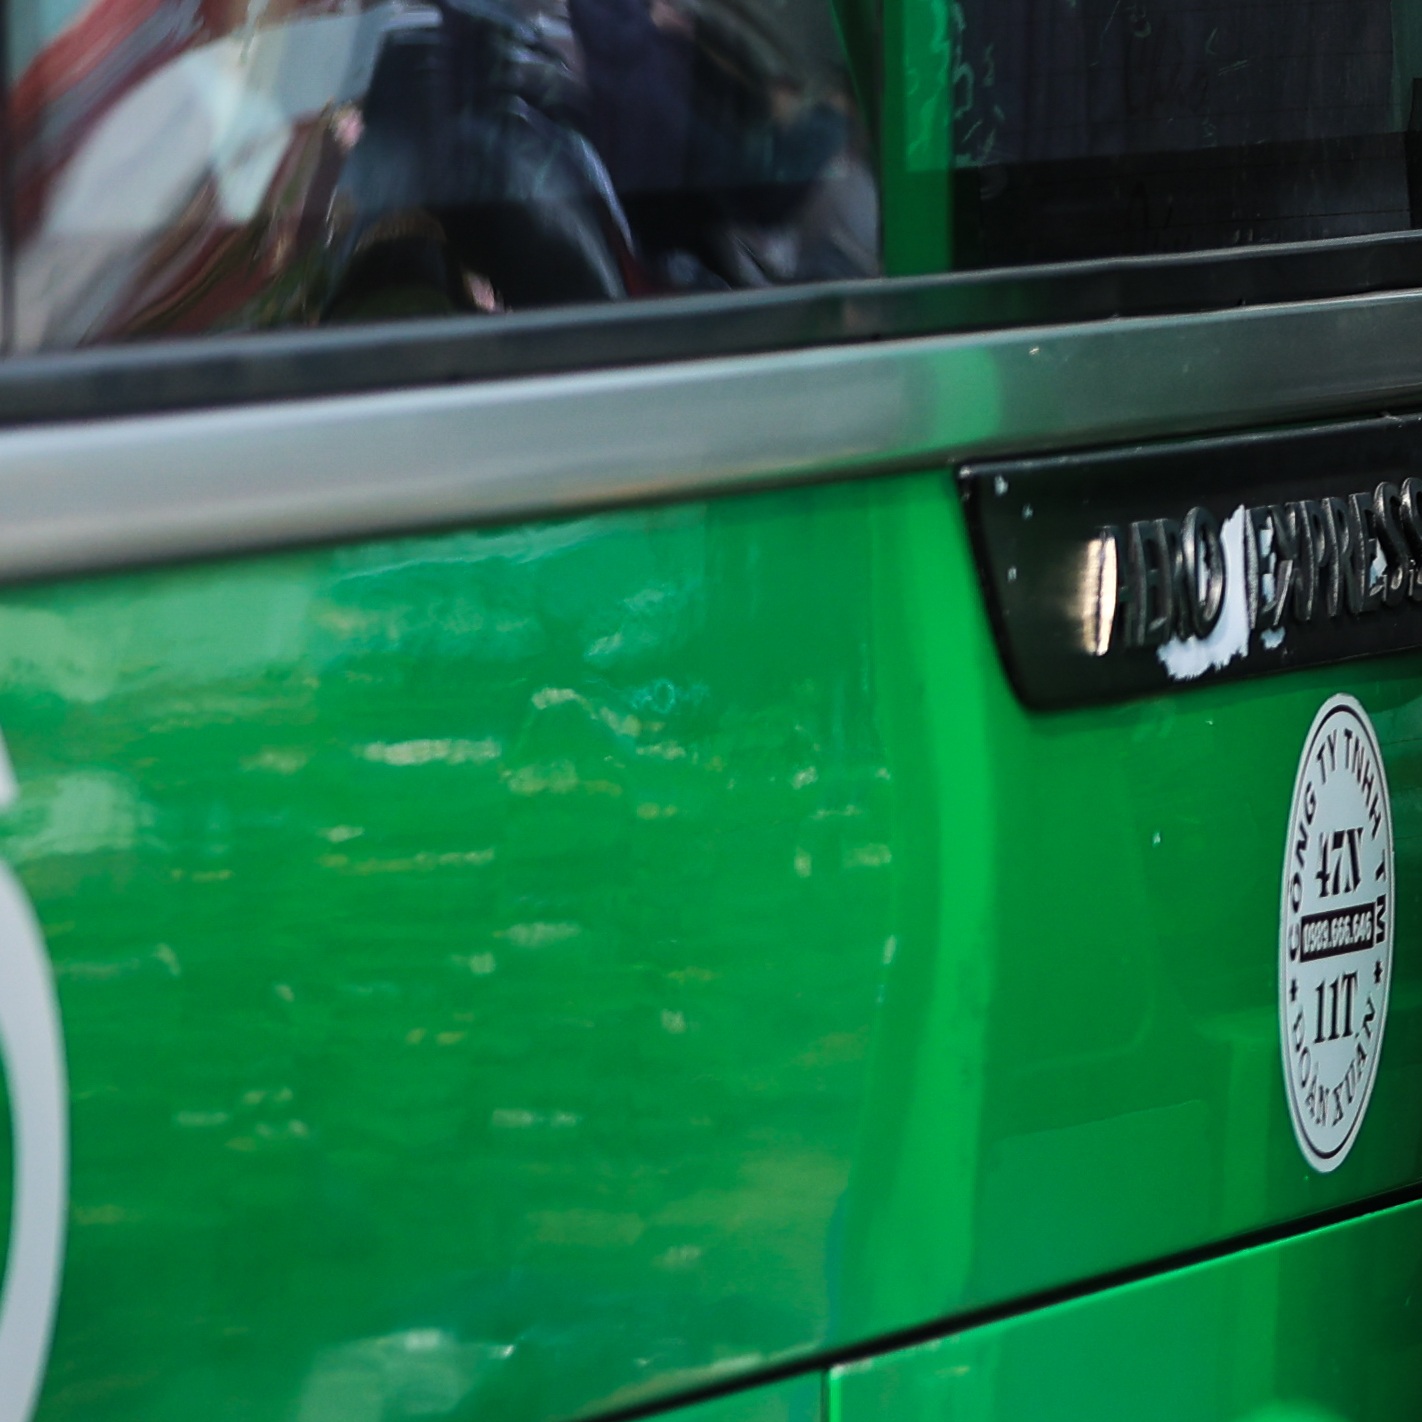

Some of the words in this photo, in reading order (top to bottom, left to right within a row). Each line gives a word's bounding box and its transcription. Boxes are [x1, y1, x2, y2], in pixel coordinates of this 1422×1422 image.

[1098, 506, 1226, 657] AERO
[1287, 781, 1317, 962] CÔNG
[1315, 728, 1338, 786] TY
[1343, 727, 1382, 841] TNHH
[1374, 848, 1387, 945] TM
[1313, 969, 1359, 1045] 11T
